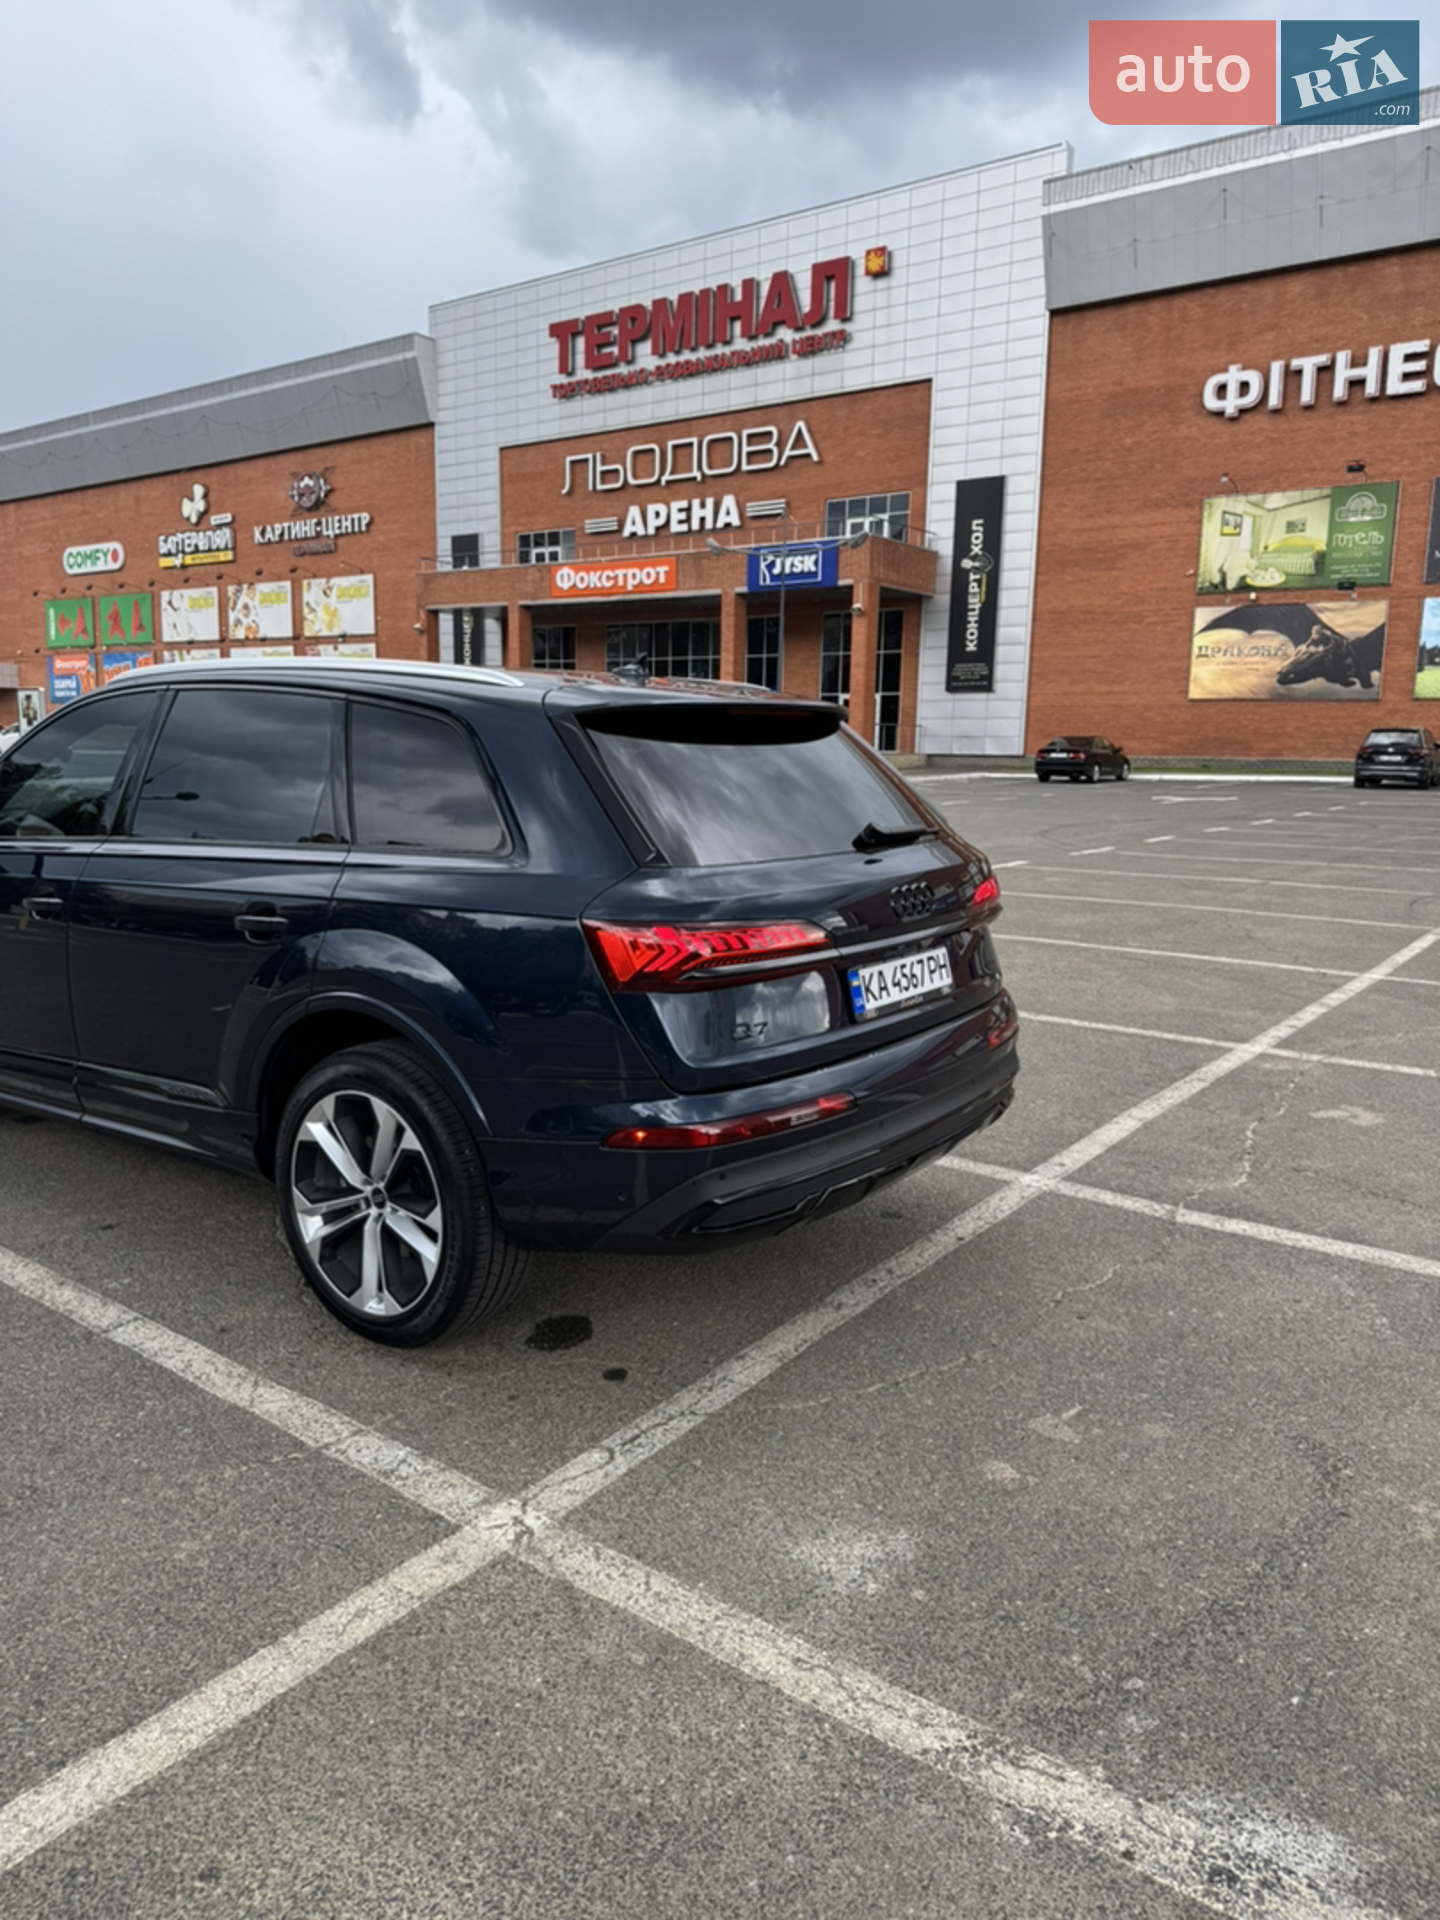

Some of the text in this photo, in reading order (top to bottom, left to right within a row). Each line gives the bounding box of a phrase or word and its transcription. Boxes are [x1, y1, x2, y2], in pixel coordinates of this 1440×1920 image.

[549, 256, 851, 374] ТЕРМІНАЛ
[791, 329, 848, 356] ЦЕНТР
[1202, 338, 1440, 418] ФІТНЕ
[561, 420, 819, 495] ЛЬОДОВА
[253, 512, 370, 544] КАРТИНГ-ЦЕНТР
[622, 494, 741, 538] АРЕНА
[970, 519, 984, 555] ХОЛ
[66, 547, 110, 569] COMFY
[772, 554, 817, 575] JYSK
[555, 565, 669, 591] Фокстрот
[966, 573, 982, 651] КОНЦЕРТ
[862, 953, 950, 1003] KA 4567 PH
[731, 1022, 768, 1041] Q7
